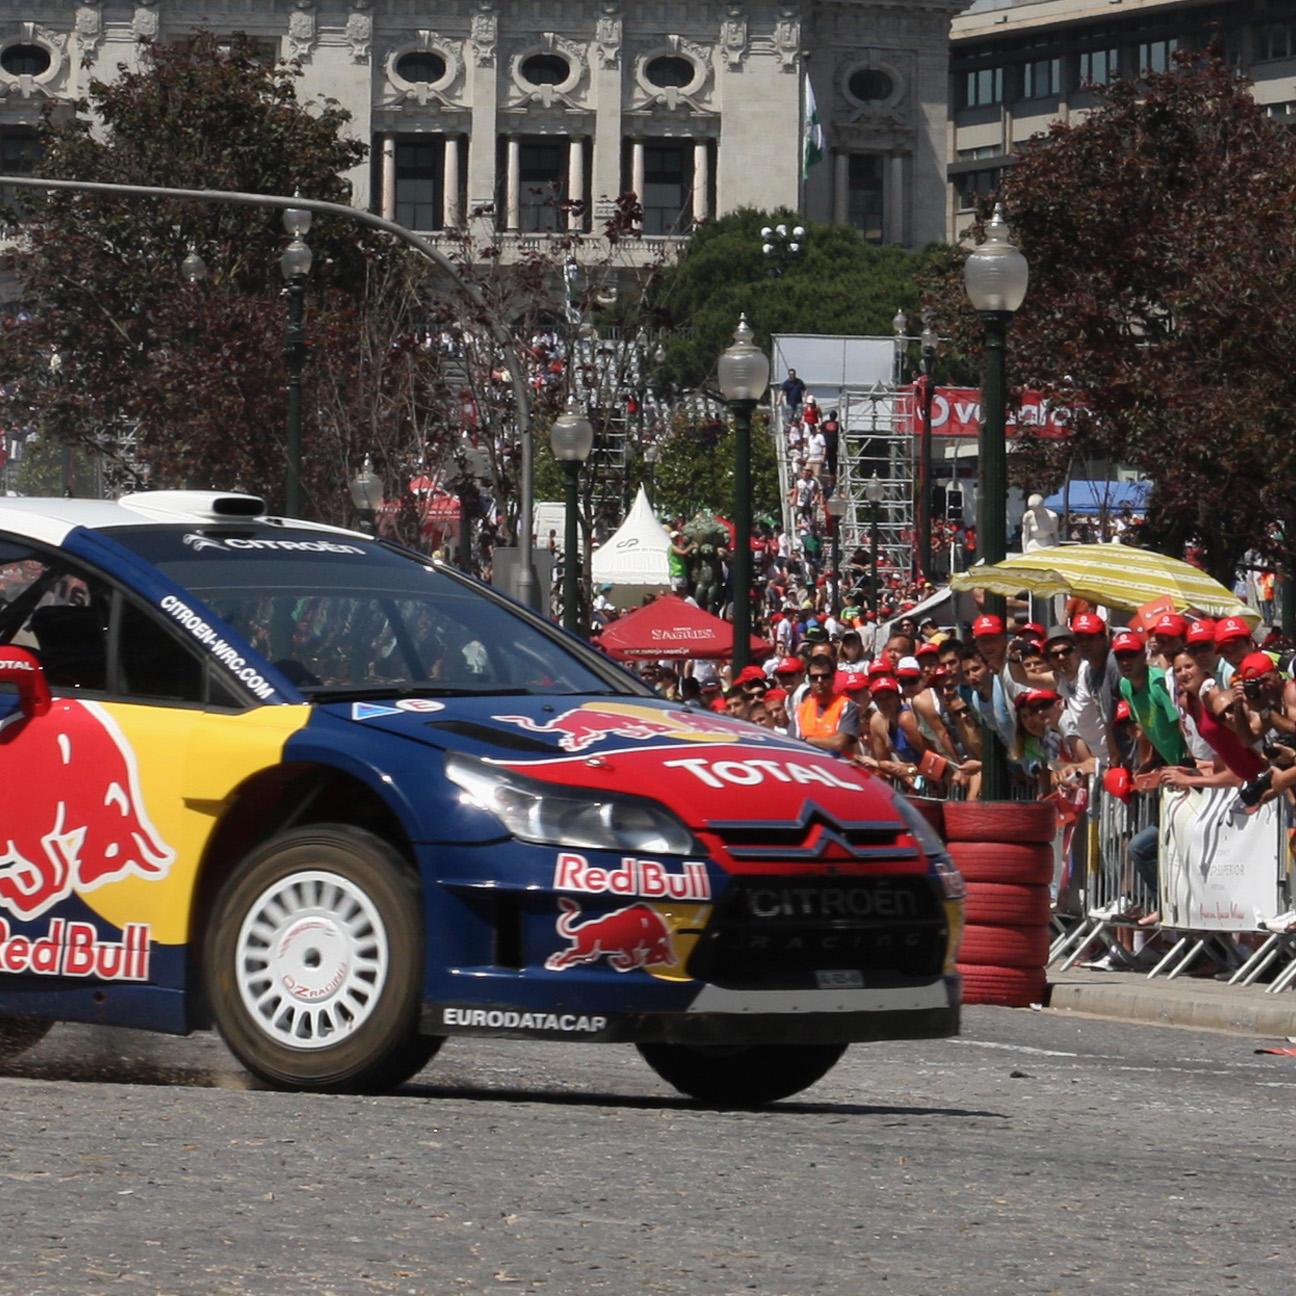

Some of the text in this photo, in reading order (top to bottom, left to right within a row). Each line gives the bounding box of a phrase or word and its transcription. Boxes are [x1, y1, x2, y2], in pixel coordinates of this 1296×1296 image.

[223, 538, 367, 556] CITROËN
[160, 594, 276, 700] CITROEN-WRC.COM
[663, 757, 864, 792] TOTAL
[443, 1007, 607, 1033] EURODATACAR
